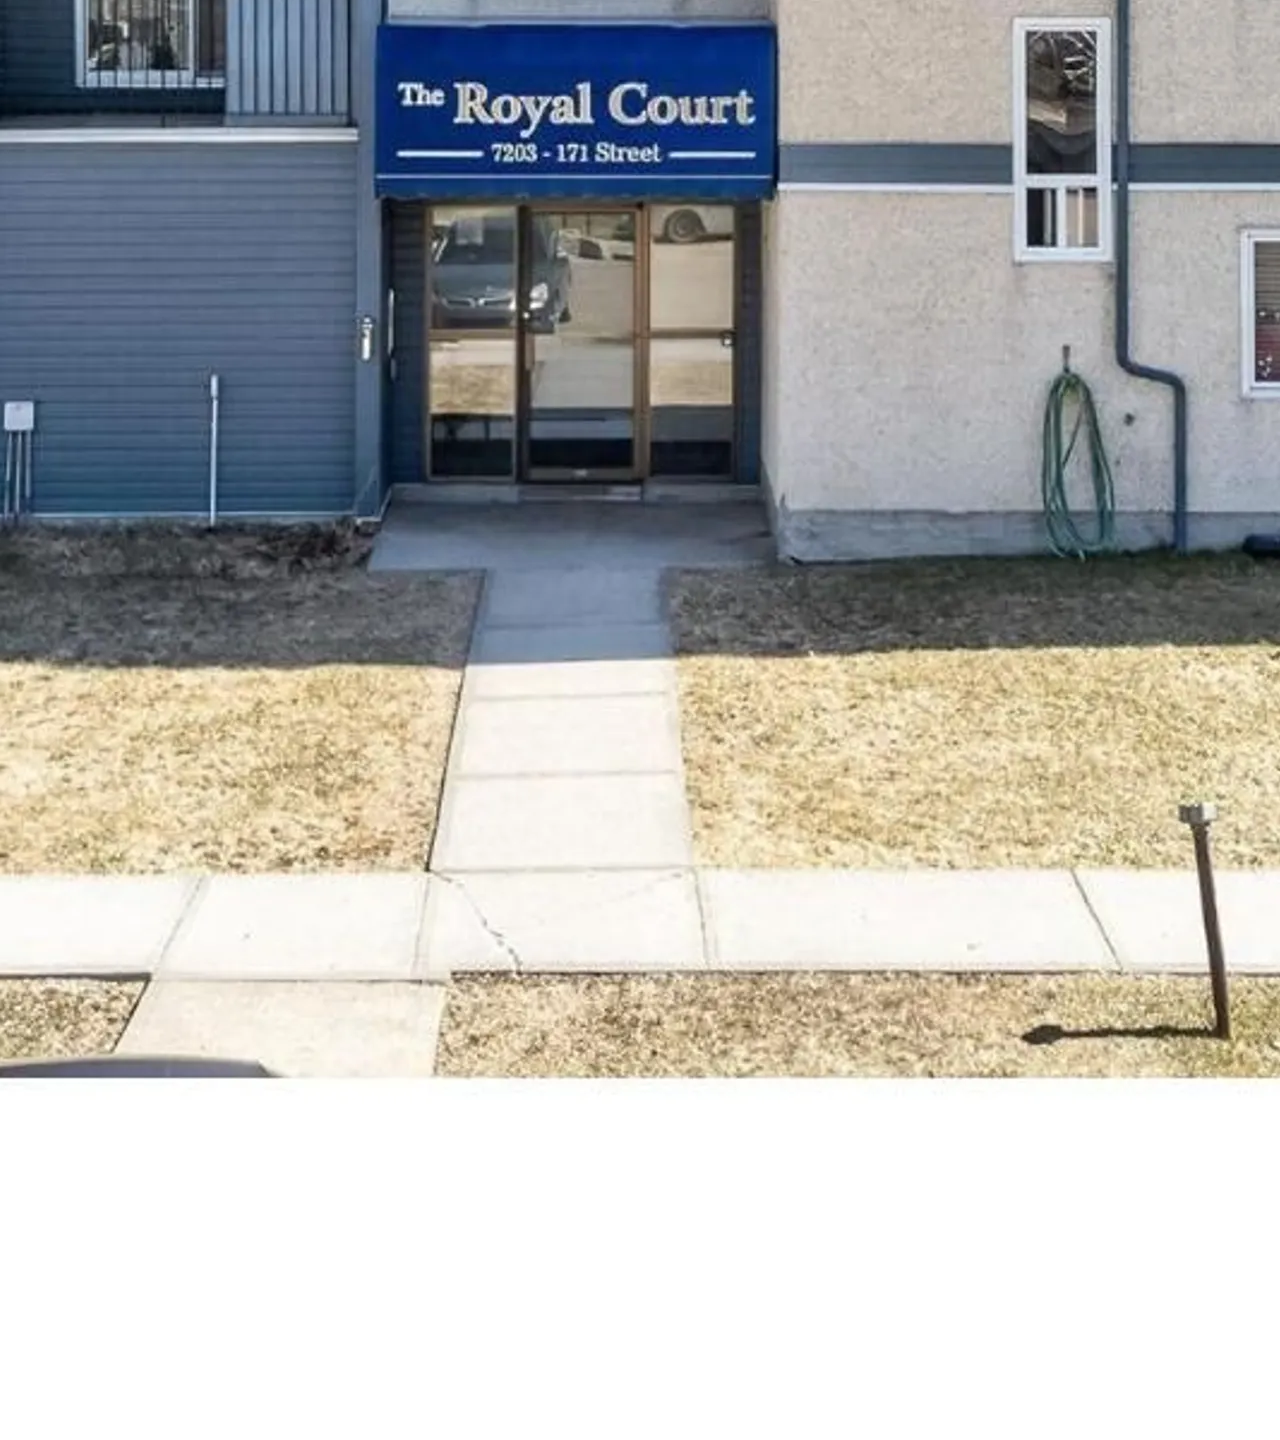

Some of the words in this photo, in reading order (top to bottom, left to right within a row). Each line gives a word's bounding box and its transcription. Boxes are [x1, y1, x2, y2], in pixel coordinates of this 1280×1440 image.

[396, 81, 446, 107] The
[452, 80, 595, 139] Royal
[607, 81, 757, 126] Court
[490, 142, 539, 163] 7203
[556, 143, 590, 163] 171
[594, 141, 663, 163] Street
